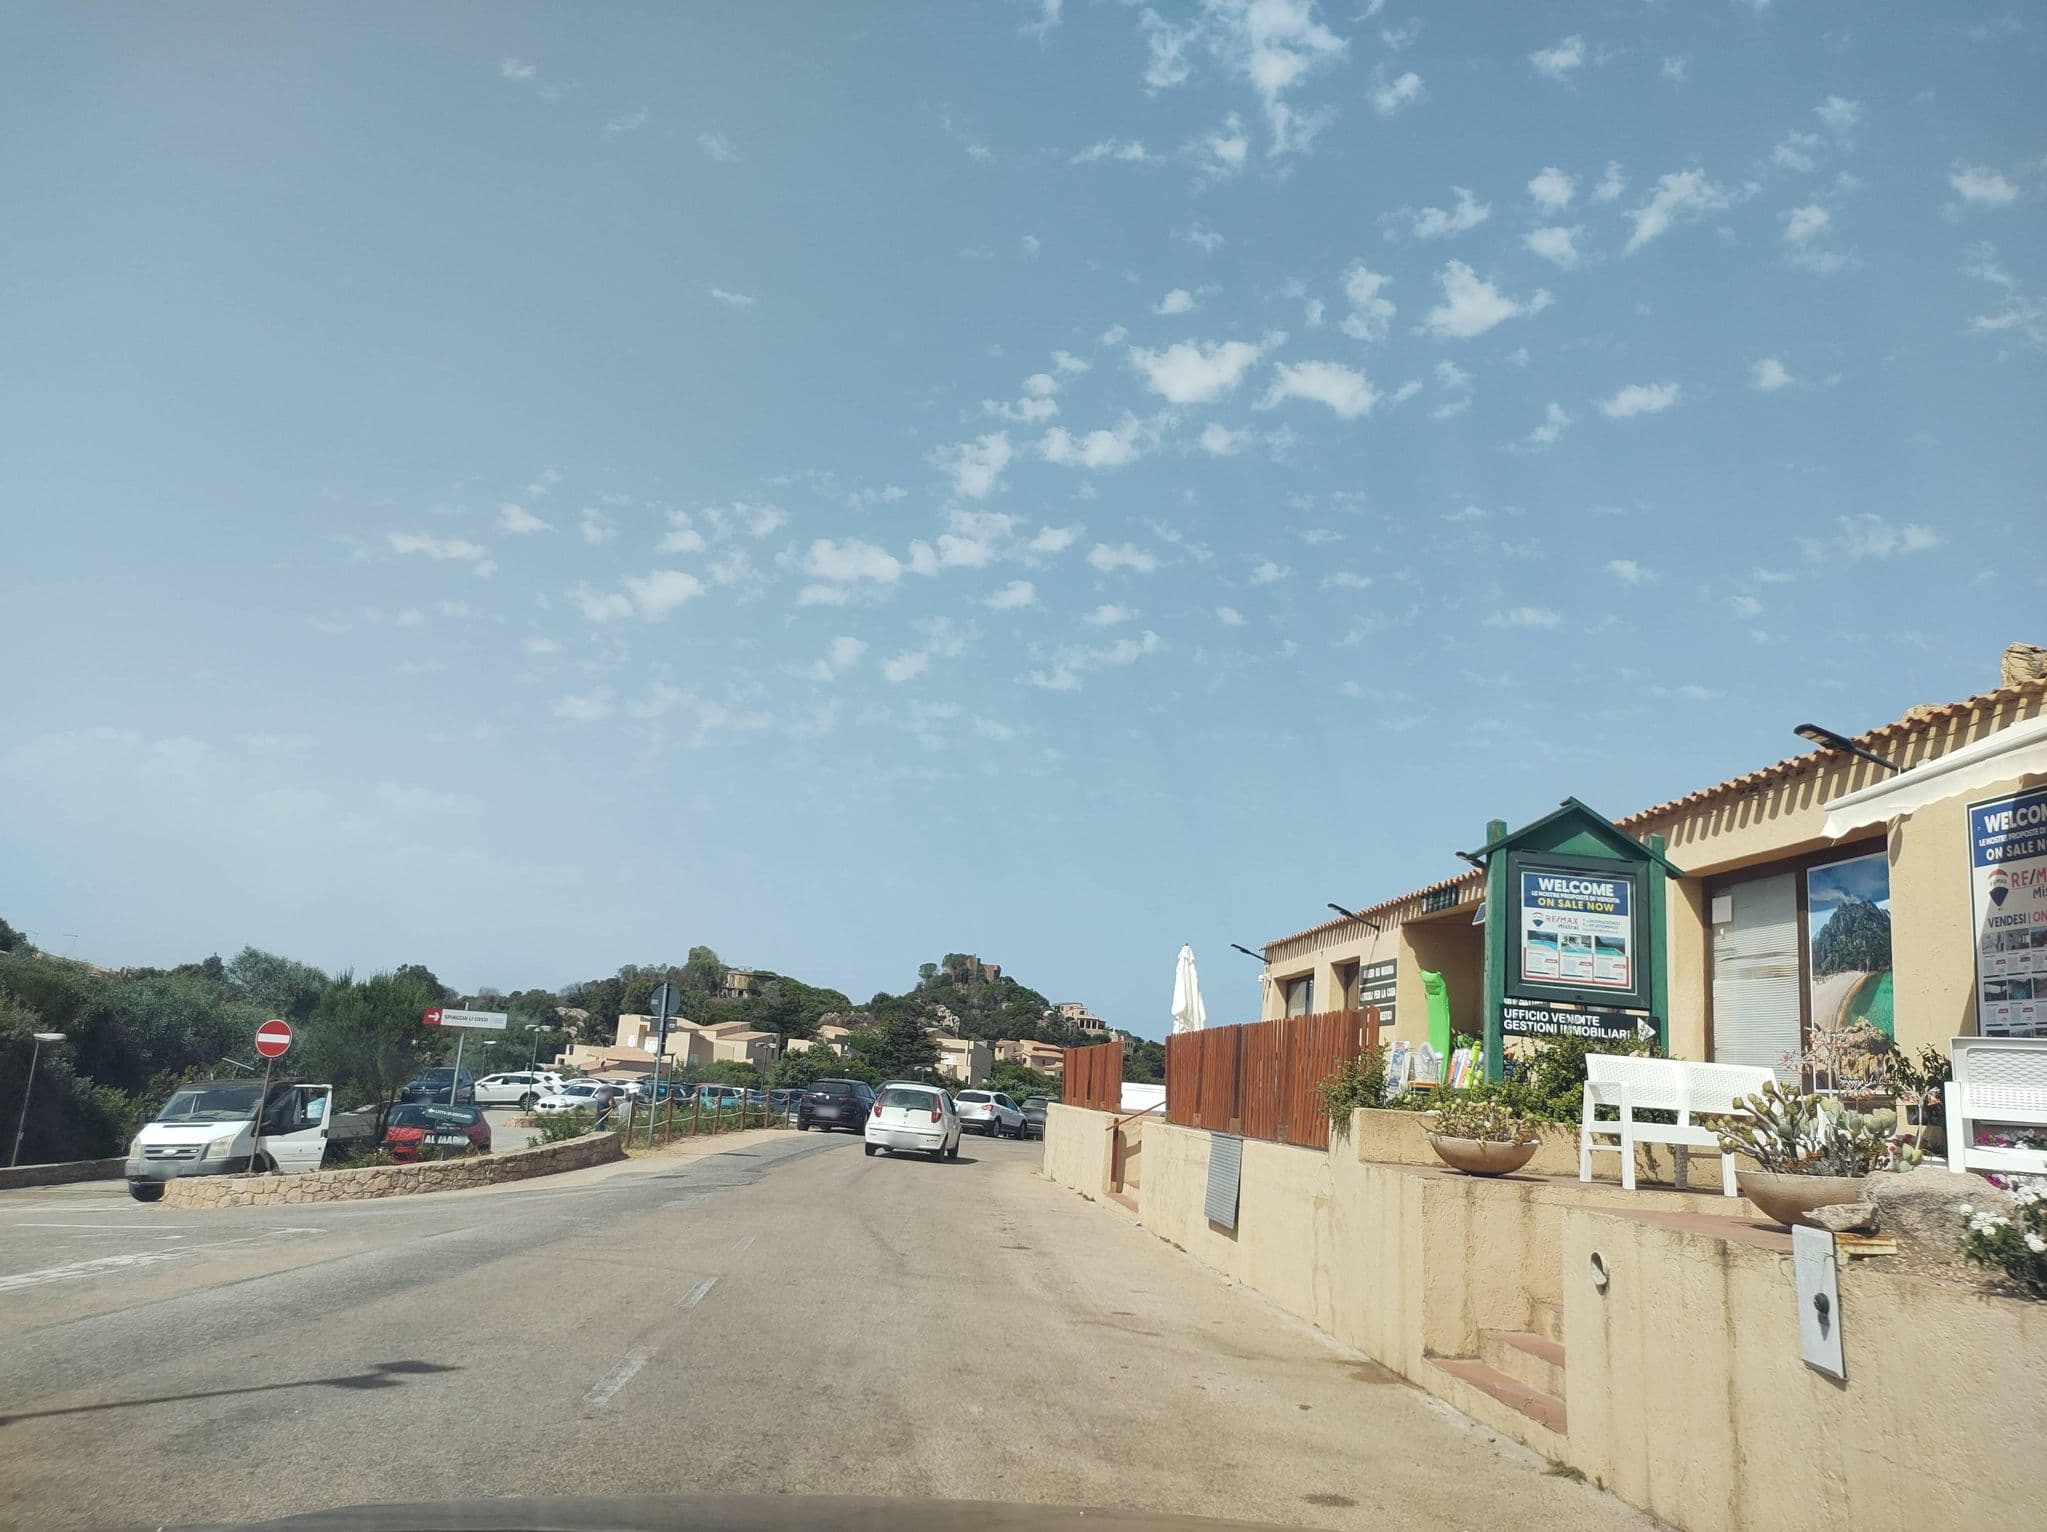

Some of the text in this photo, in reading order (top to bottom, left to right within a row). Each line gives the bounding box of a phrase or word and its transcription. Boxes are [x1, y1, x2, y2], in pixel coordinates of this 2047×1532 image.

[1986, 838, 2047, 861] ON SALE N
[1537, 877, 1614, 897] WELCOME
[1537, 897, 1614, 912] ON SALE NOW
[1545, 915, 1578, 924] RE/MAX
[1988, 912, 2027, 929] VENDESI
[1503, 1008, 1600, 1026] UFFICIO VENDITE
[1503, 1019, 1557, 1034] GESTIONI
